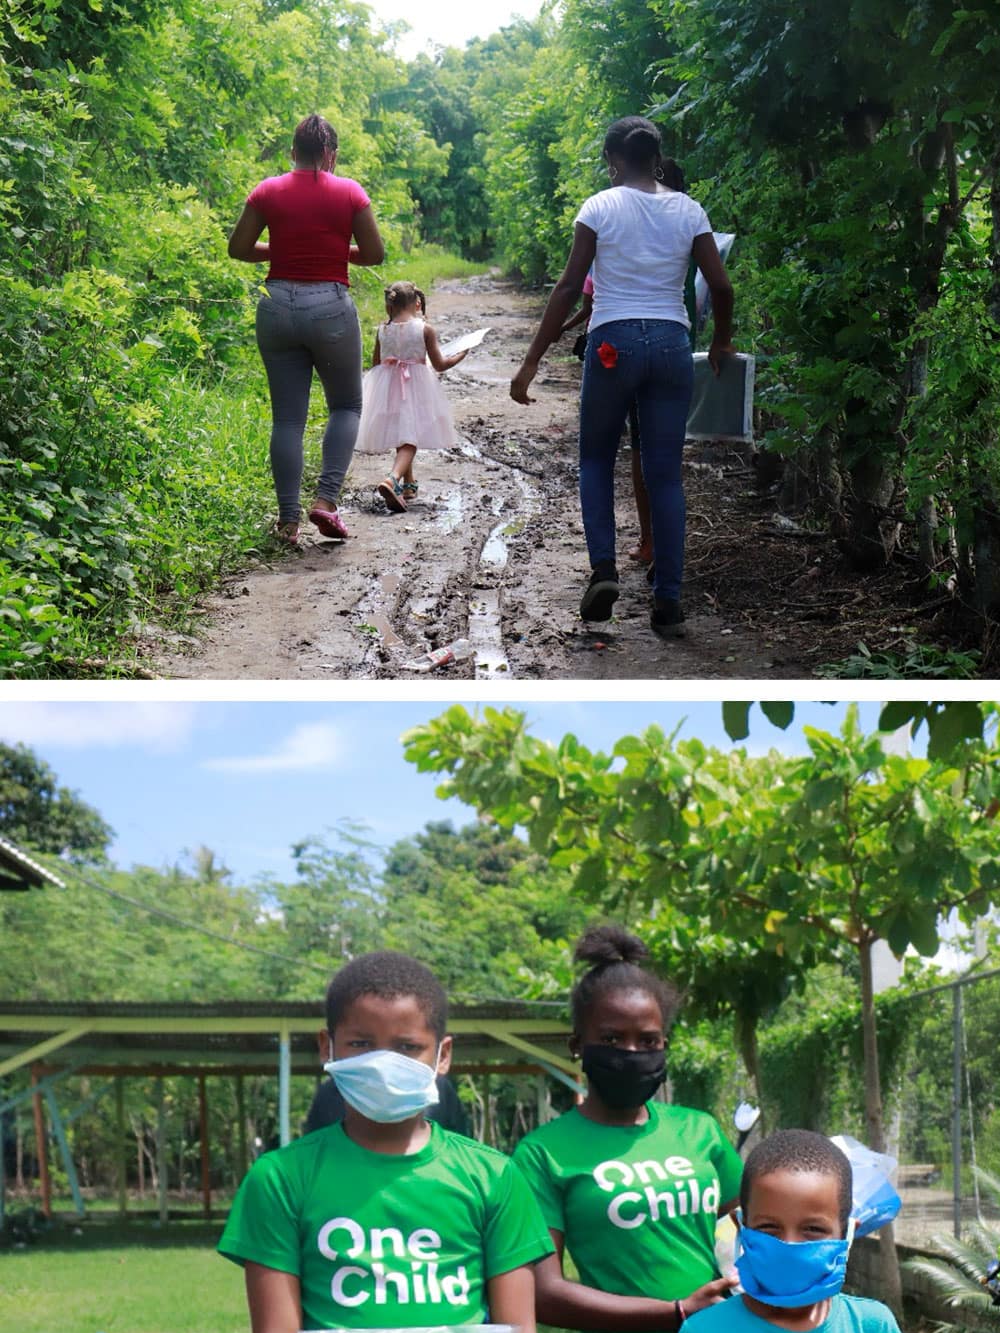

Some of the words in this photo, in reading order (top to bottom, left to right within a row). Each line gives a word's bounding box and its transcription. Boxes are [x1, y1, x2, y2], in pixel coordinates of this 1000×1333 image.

[593, 1156, 695, 1192] One
[607, 1178, 721, 1230] Child
[317, 1216, 442, 1261] One
[331, 1261, 470, 1307] Child
